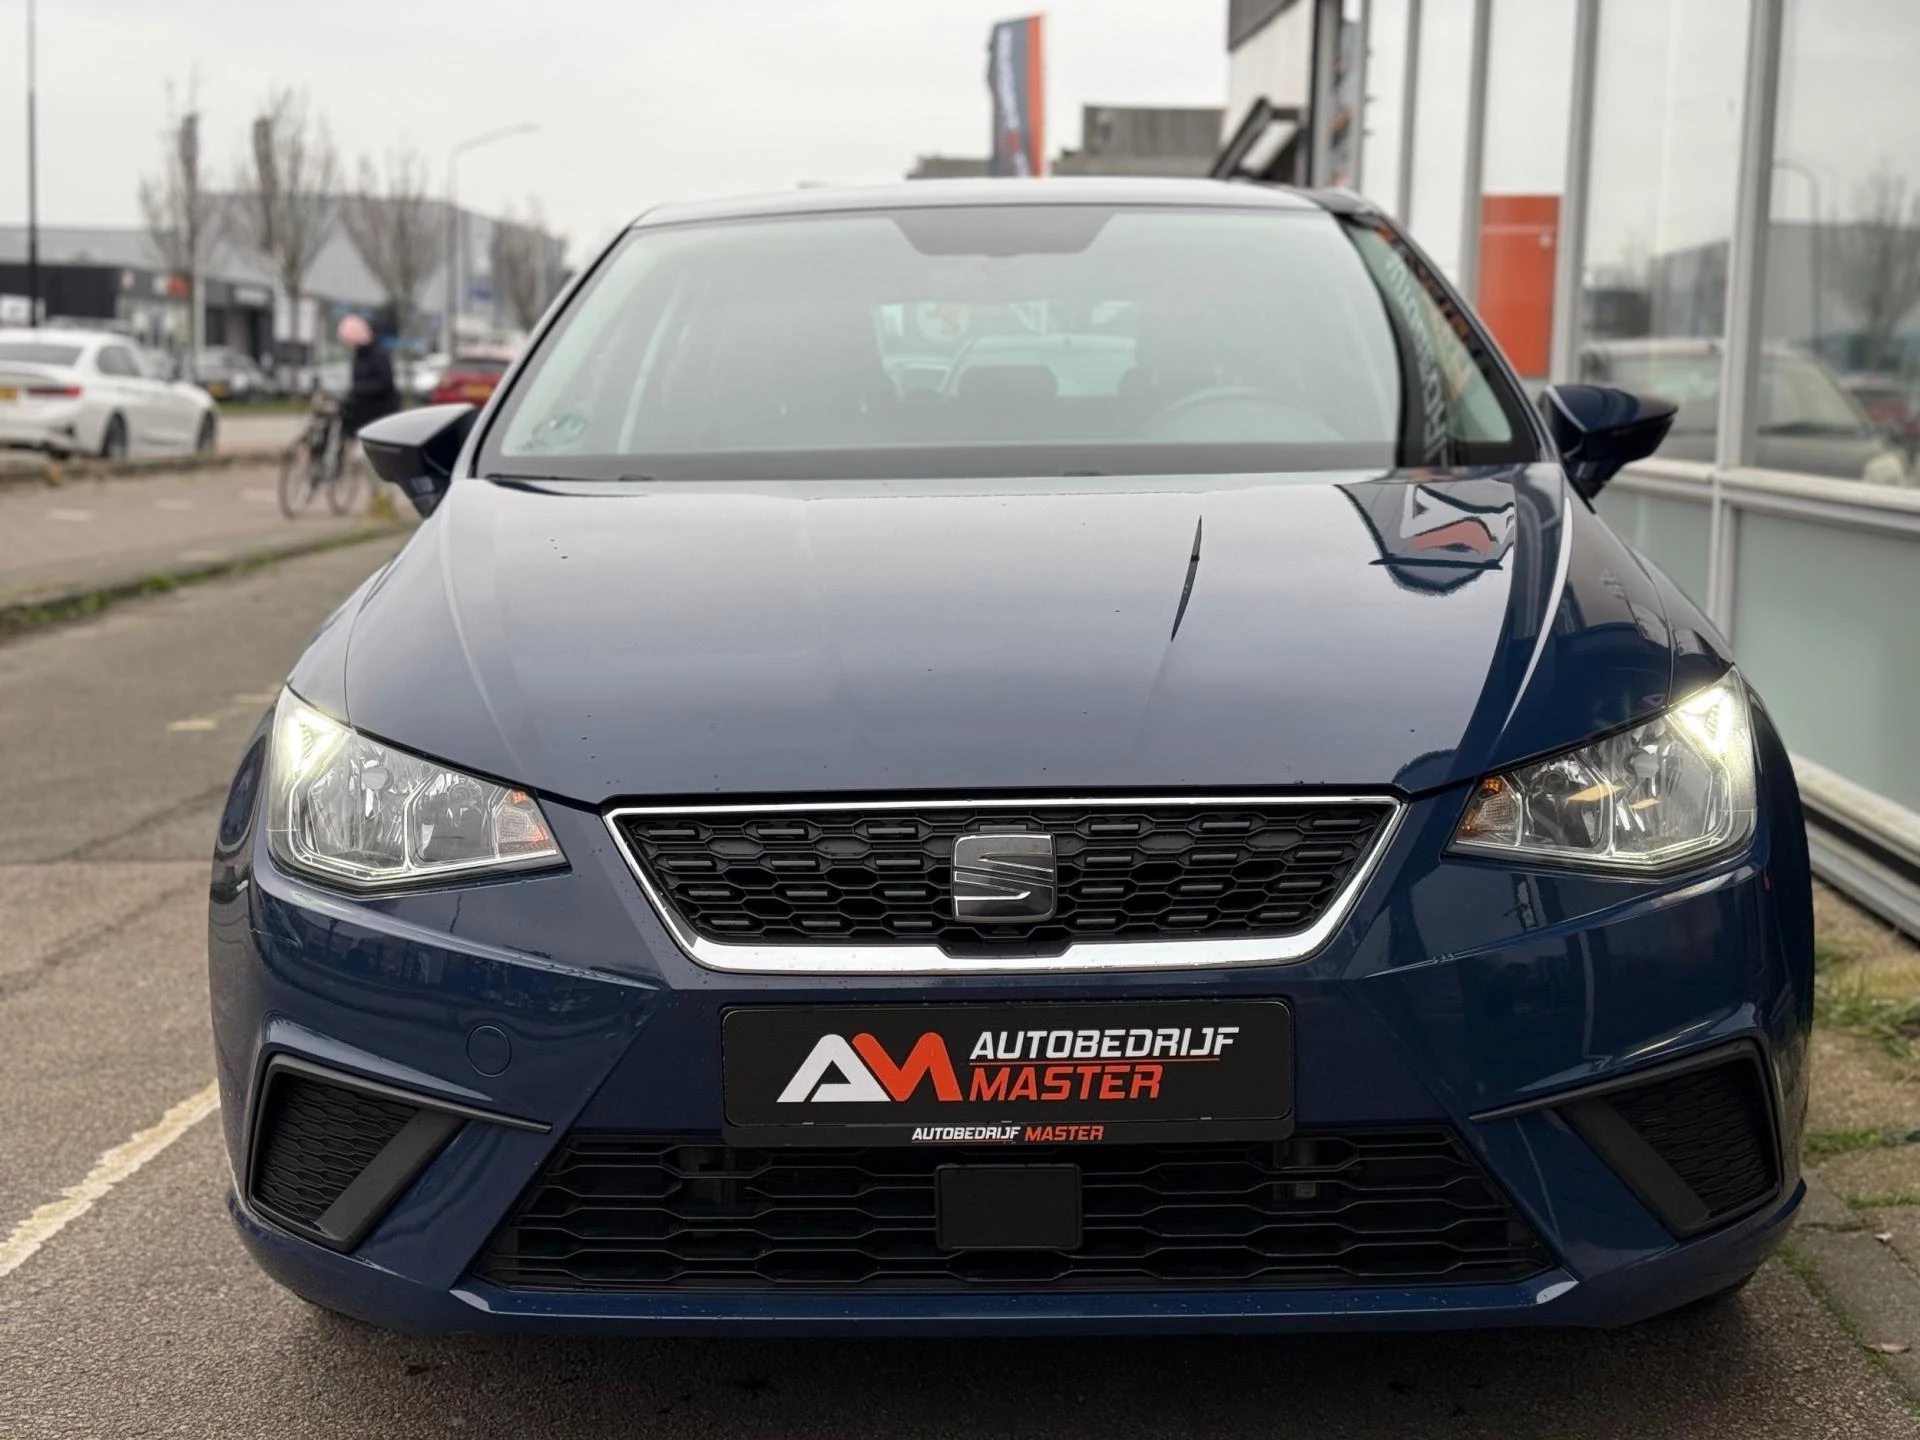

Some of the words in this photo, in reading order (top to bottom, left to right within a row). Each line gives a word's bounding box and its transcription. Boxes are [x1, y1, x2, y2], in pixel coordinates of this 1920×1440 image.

[969, 1026, 1240, 1060] AUTOBEDRIJF
[776, 1031, 963, 1103] AM
[968, 1063, 1164, 1102] MASTER
[911, 1126, 1021, 1141] AUTOBEDRIJF
[1024, 1125, 1105, 1142] MASTER
